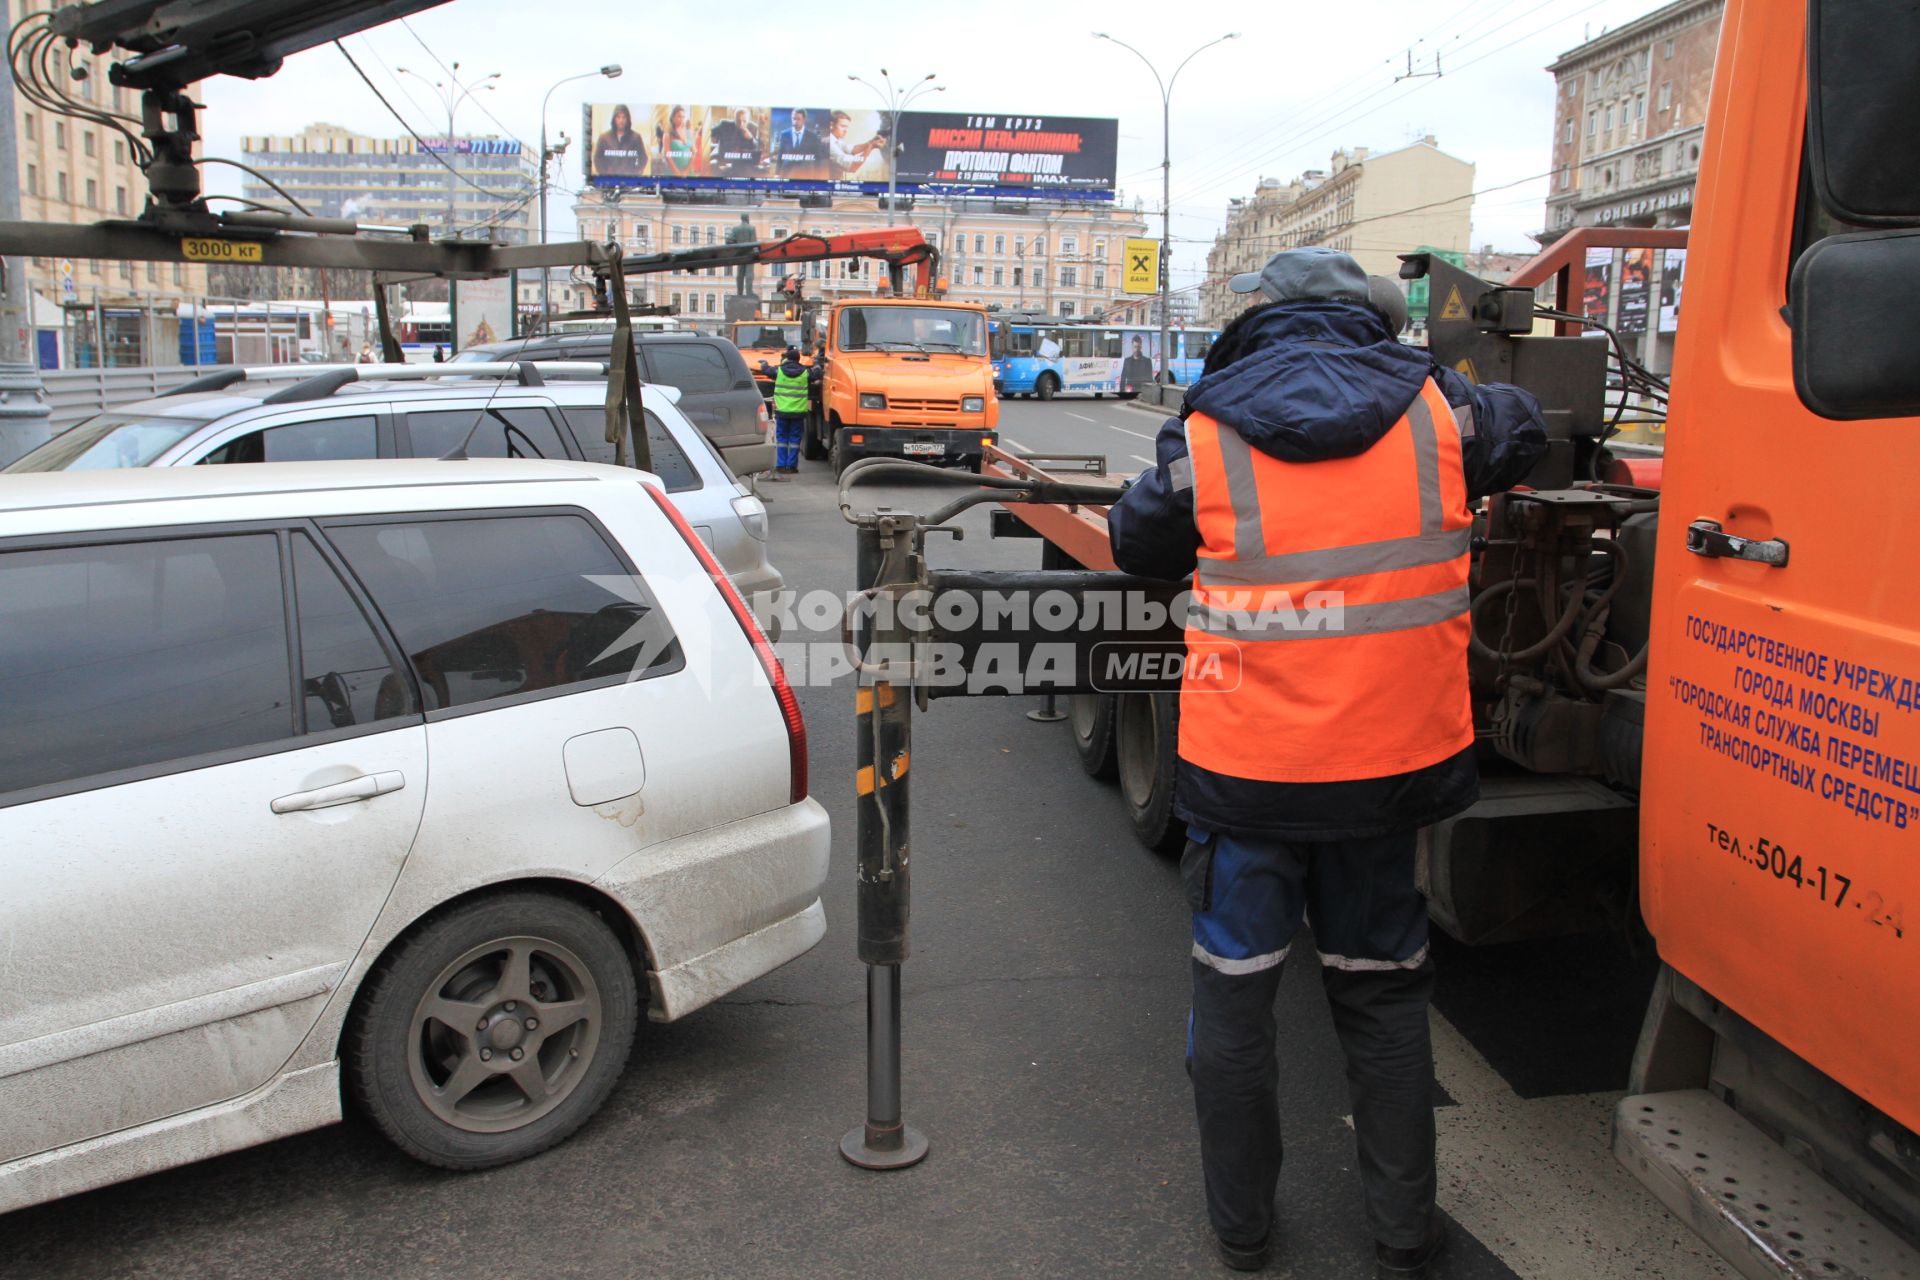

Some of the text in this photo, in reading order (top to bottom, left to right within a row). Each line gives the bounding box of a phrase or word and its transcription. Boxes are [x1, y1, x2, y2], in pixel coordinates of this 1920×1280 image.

[967, 116, 1042, 130] ТОМ КРУЗ
[928, 128, 983, 149] МИССИЯ
[943, 150, 1064, 174] ПРОТОКОЛ ФАНТОМ
[964, 172, 972, 181] 15
[1033, 174, 1069, 184] IMAX
[1594, 188, 1690, 224] КОНЦЕРТНЫЙ
[188, 241, 256, 257] 3000 кг
[1686, 615, 1828, 682] ГОСУДАРСТВЕННОЕ
[1734, 666, 1880, 737] ГОРОДА МОСКВЫ
[1755, 710, 1821, 757] СЛУЖБА
[1700, 722, 1815, 792] ТРАНСПОРТНЫХ
